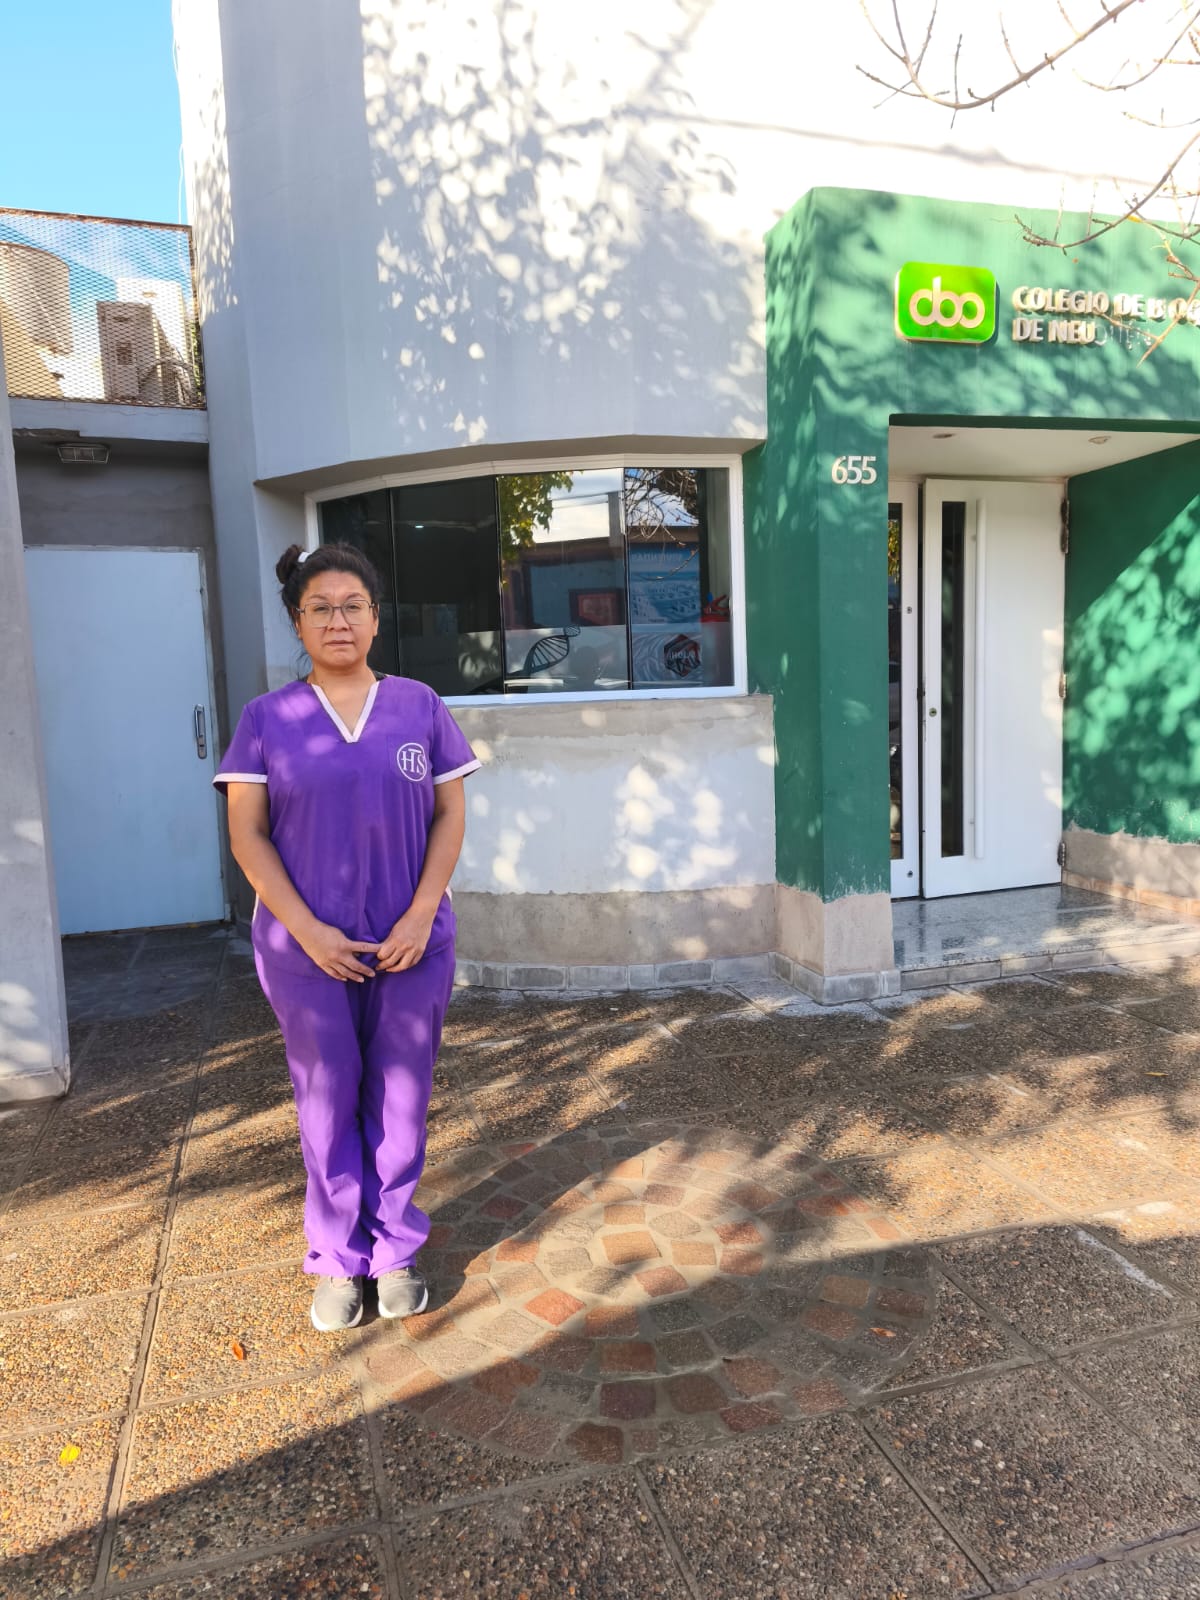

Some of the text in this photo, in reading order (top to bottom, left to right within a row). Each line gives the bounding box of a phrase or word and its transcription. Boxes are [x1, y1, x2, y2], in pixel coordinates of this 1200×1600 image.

[1012, 286, 1109, 314] COLEGIO
[1113, 293, 1145, 316] DE
[1012, 317, 1044, 341] DE
[831, 455, 877, 485] 655
